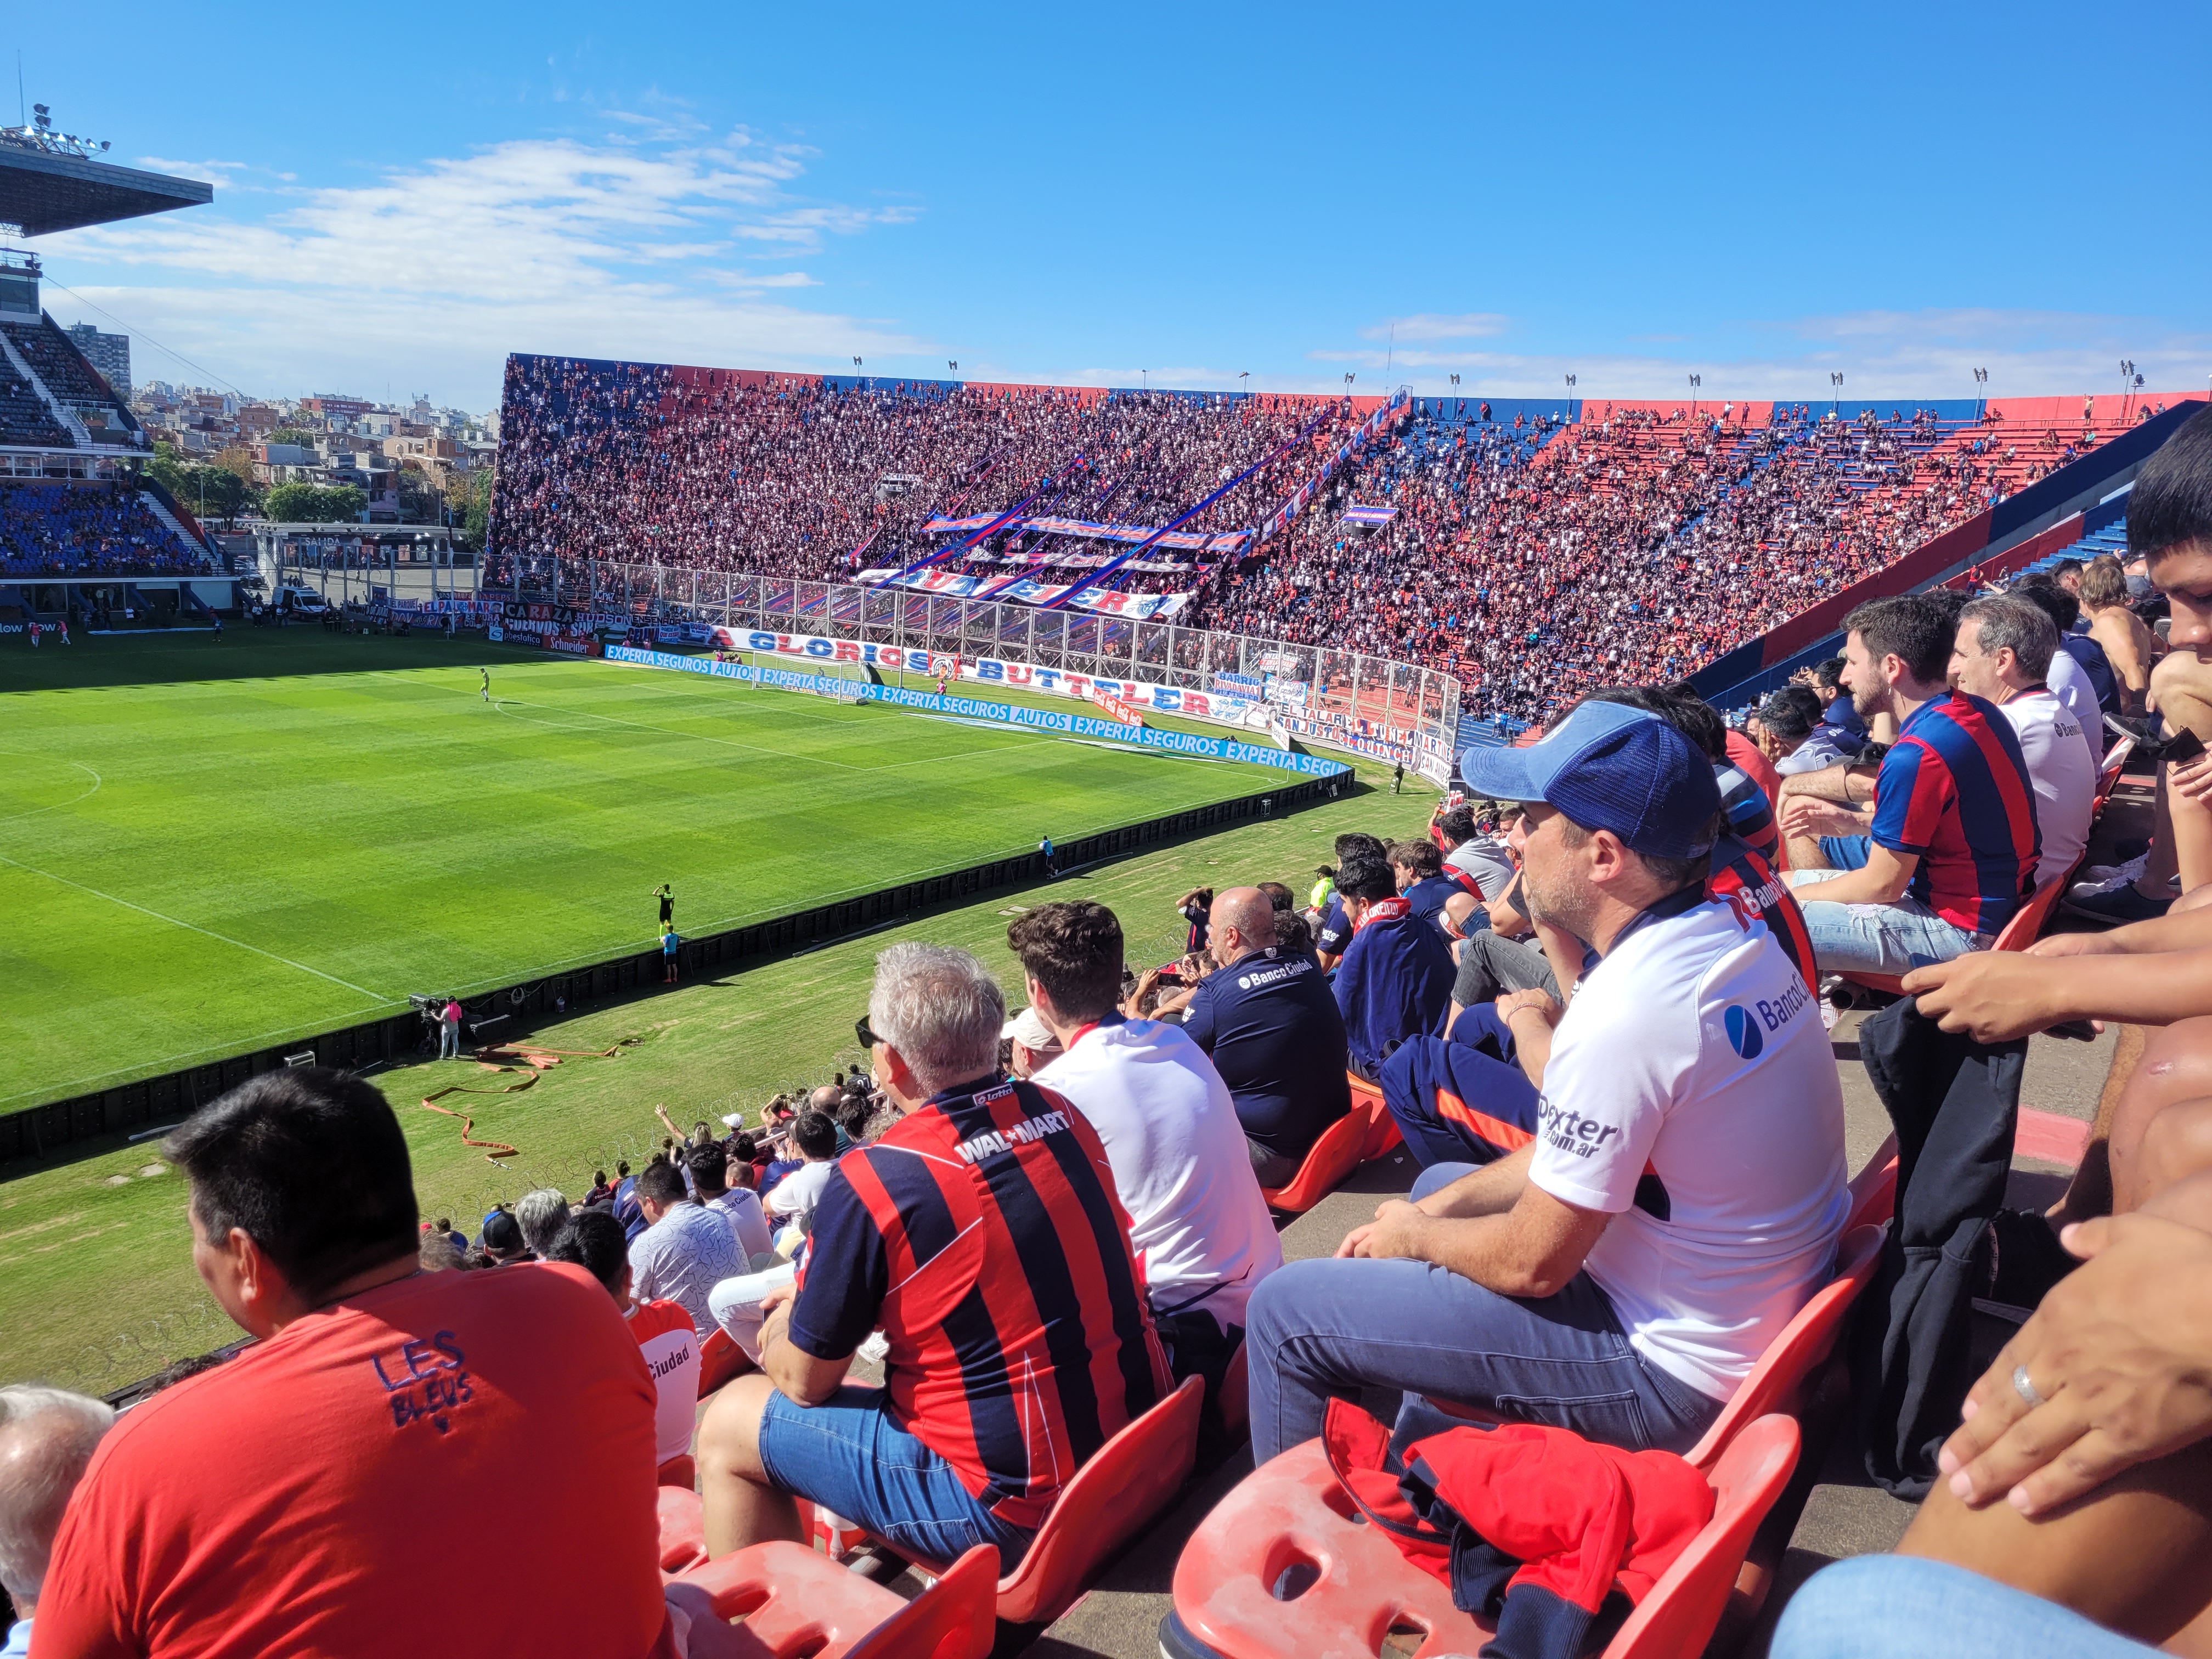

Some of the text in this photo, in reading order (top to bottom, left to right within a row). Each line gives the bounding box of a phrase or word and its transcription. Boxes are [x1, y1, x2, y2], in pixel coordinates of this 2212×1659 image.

[505, 604, 573, 623] CARAZA
[633, 614, 682, 626] ENSENADA
[550, 636, 589, 654] Schneider
[748, 631, 964, 676] GLORIOS
[976, 659, 1211, 714] BUTTELER
[1215, 679, 1255, 695] RIVADAVIA
[607, 645, 654, 666] EXPERTA
[656, 653, 709, 674] SEGUROS
[715, 664, 757, 681] AUTOS
[763, 670, 815, 690] EXPERTA
[817, 678, 877, 699] SEGUROS
[882, 687, 940, 711] EXPERTA
[942, 697, 1009, 720] SEGUROS
[1015, 708, 1066, 730] AUTOS
[1074, 716, 1142, 743] EXPERTA
[1143, 729, 1221, 755] SEGUROS
[1225, 742, 1297, 771] EXPERTA
[1281, 704, 1297, 715] EL
[1301, 707, 1342, 726] TALAR
[1277, 715, 1300, 732] SAN
[1301, 718, 1339, 740] JUSTO
[1338, 732, 1353, 749] EL
[1345, 715, 1414, 746] EL TUNEL
[1737, 881, 1782, 915] Banco
[1249, 958, 1313, 986] Banco Ciudad
[1756, 985, 1803, 1032] Banco
[1538, 1094, 1618, 1144] Dexter
[371, 1330, 465, 1391] LES
